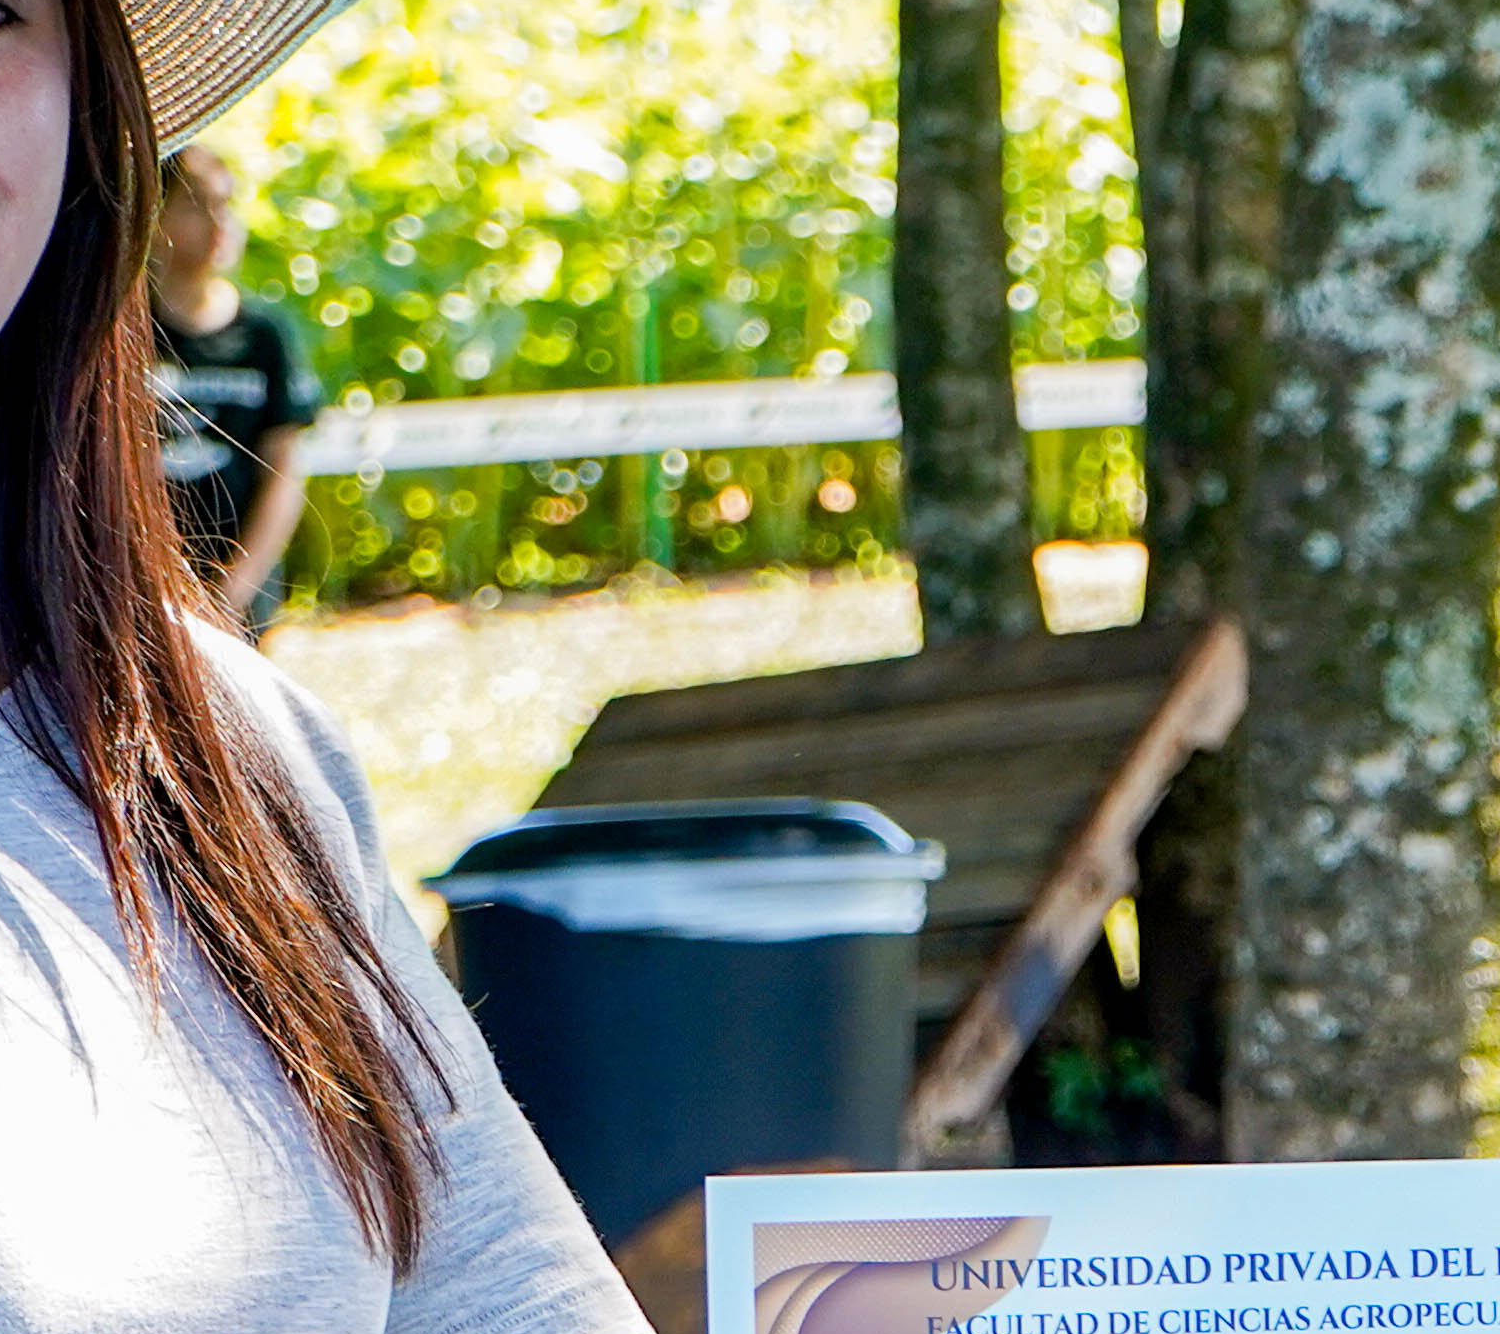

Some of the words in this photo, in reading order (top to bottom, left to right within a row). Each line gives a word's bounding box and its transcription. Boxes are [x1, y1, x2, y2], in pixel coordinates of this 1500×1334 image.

[931, 1254, 1212, 1291] UNIVERSIDAD
[1223, 1250, 1400, 1283] PRIVADA
[1410, 1247, 1485, 1279] DEL
[1159, 1306, 1310, 1334] CIENCIAS
